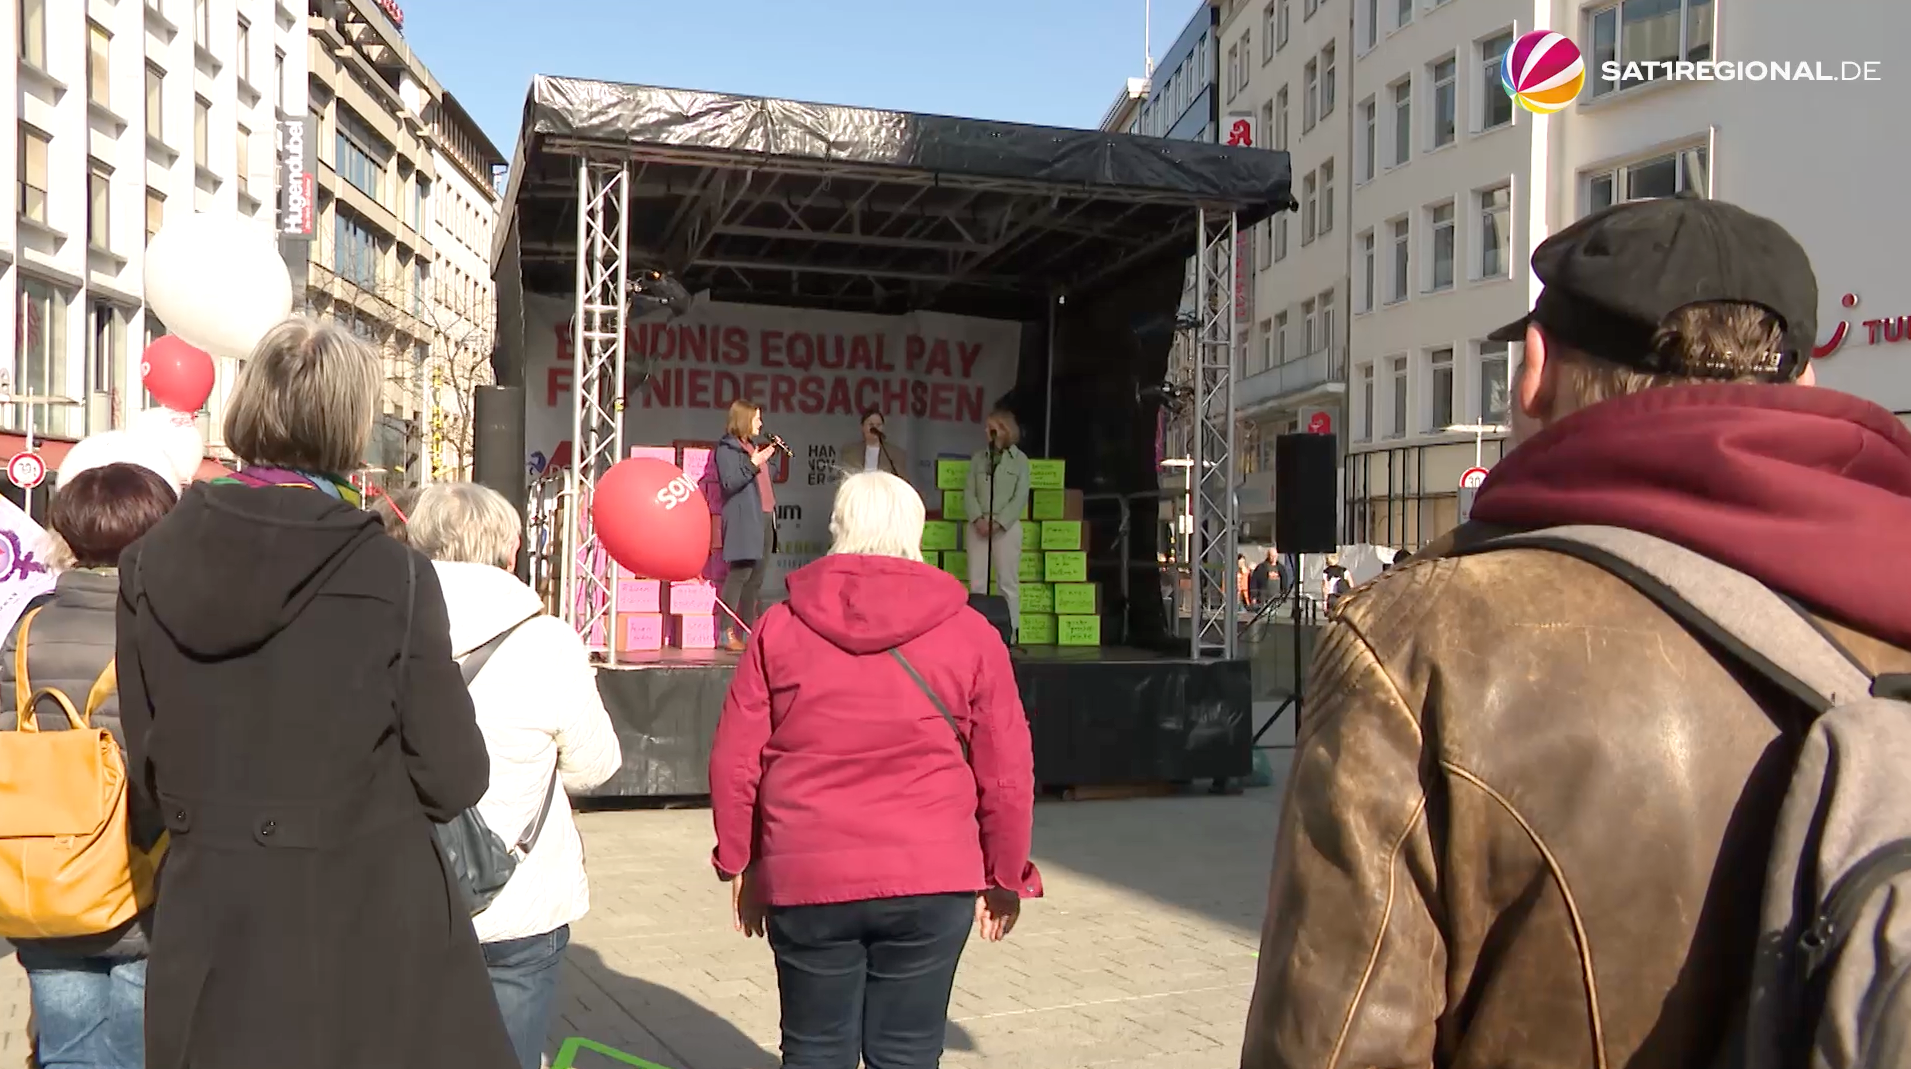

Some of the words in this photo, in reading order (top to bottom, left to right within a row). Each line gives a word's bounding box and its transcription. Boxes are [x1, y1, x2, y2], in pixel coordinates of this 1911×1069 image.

[283, 120, 307, 234] Hugendubel
[759, 330, 896, 373] EQUAL
[905, 334, 983, 379] PAY
[640, 366, 985, 425] NIEDERSACHSEN
[807, 472, 826, 486] ER
